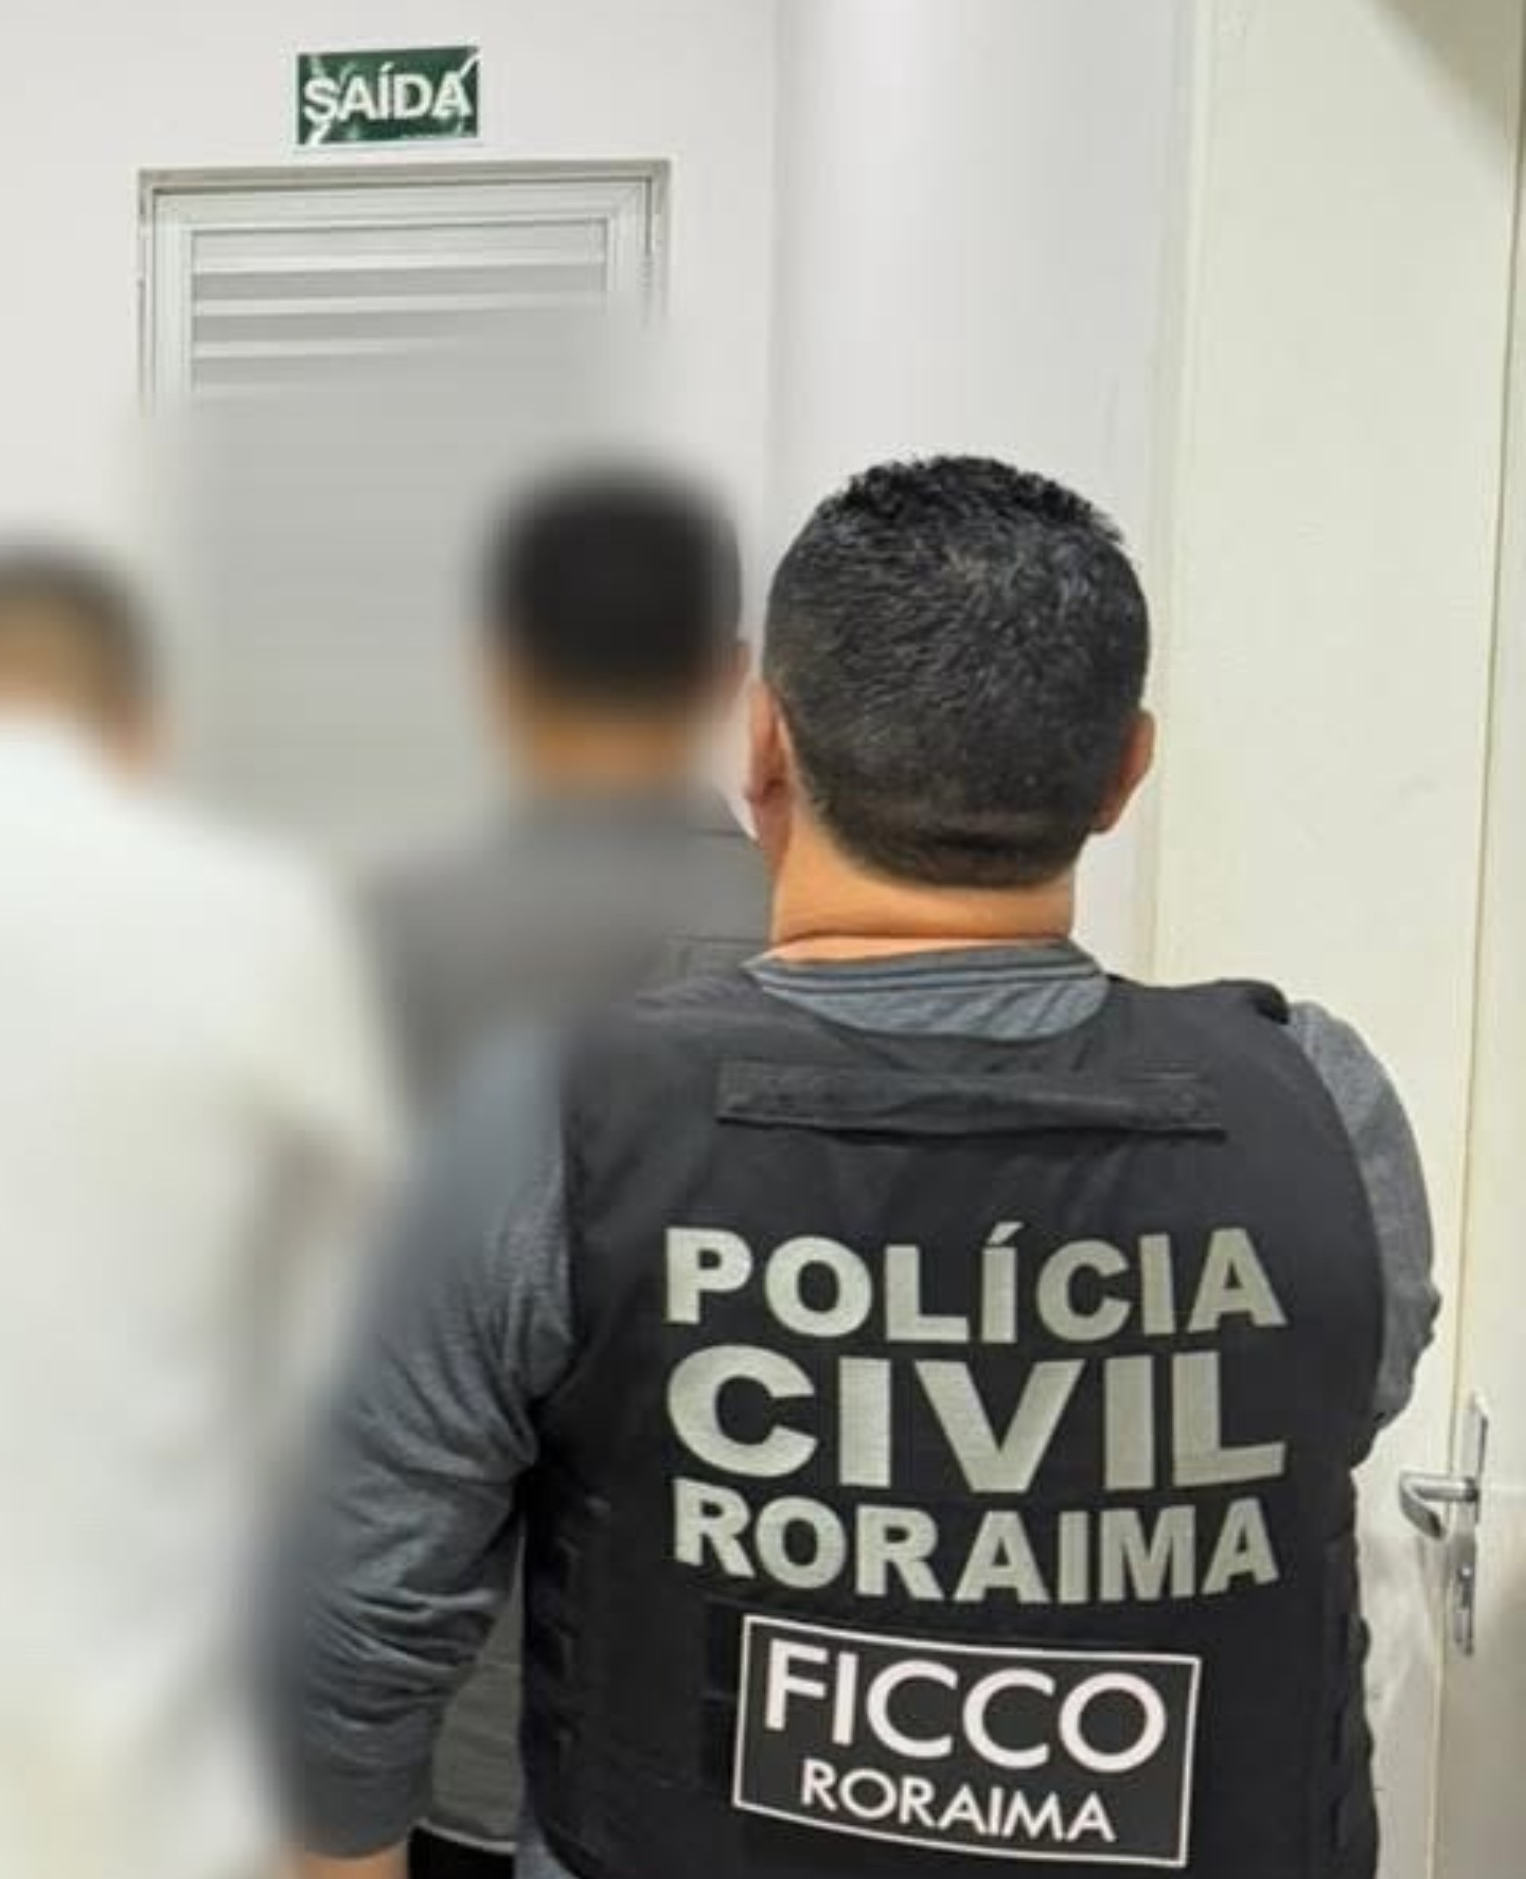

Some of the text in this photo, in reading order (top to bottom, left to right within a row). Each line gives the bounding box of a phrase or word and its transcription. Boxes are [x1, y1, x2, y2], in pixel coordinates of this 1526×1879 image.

[303, 60, 472, 121] SAÍDA
[666, 1221, 1287, 1343] POLÍCIA
[666, 1344, 1286, 1493] CIVIL
[673, 1477, 1279, 1604] RORAIMA
[764, 1638, 1168, 1773] FICCO
[801, 1758, 1116, 1842] RORAIMA
